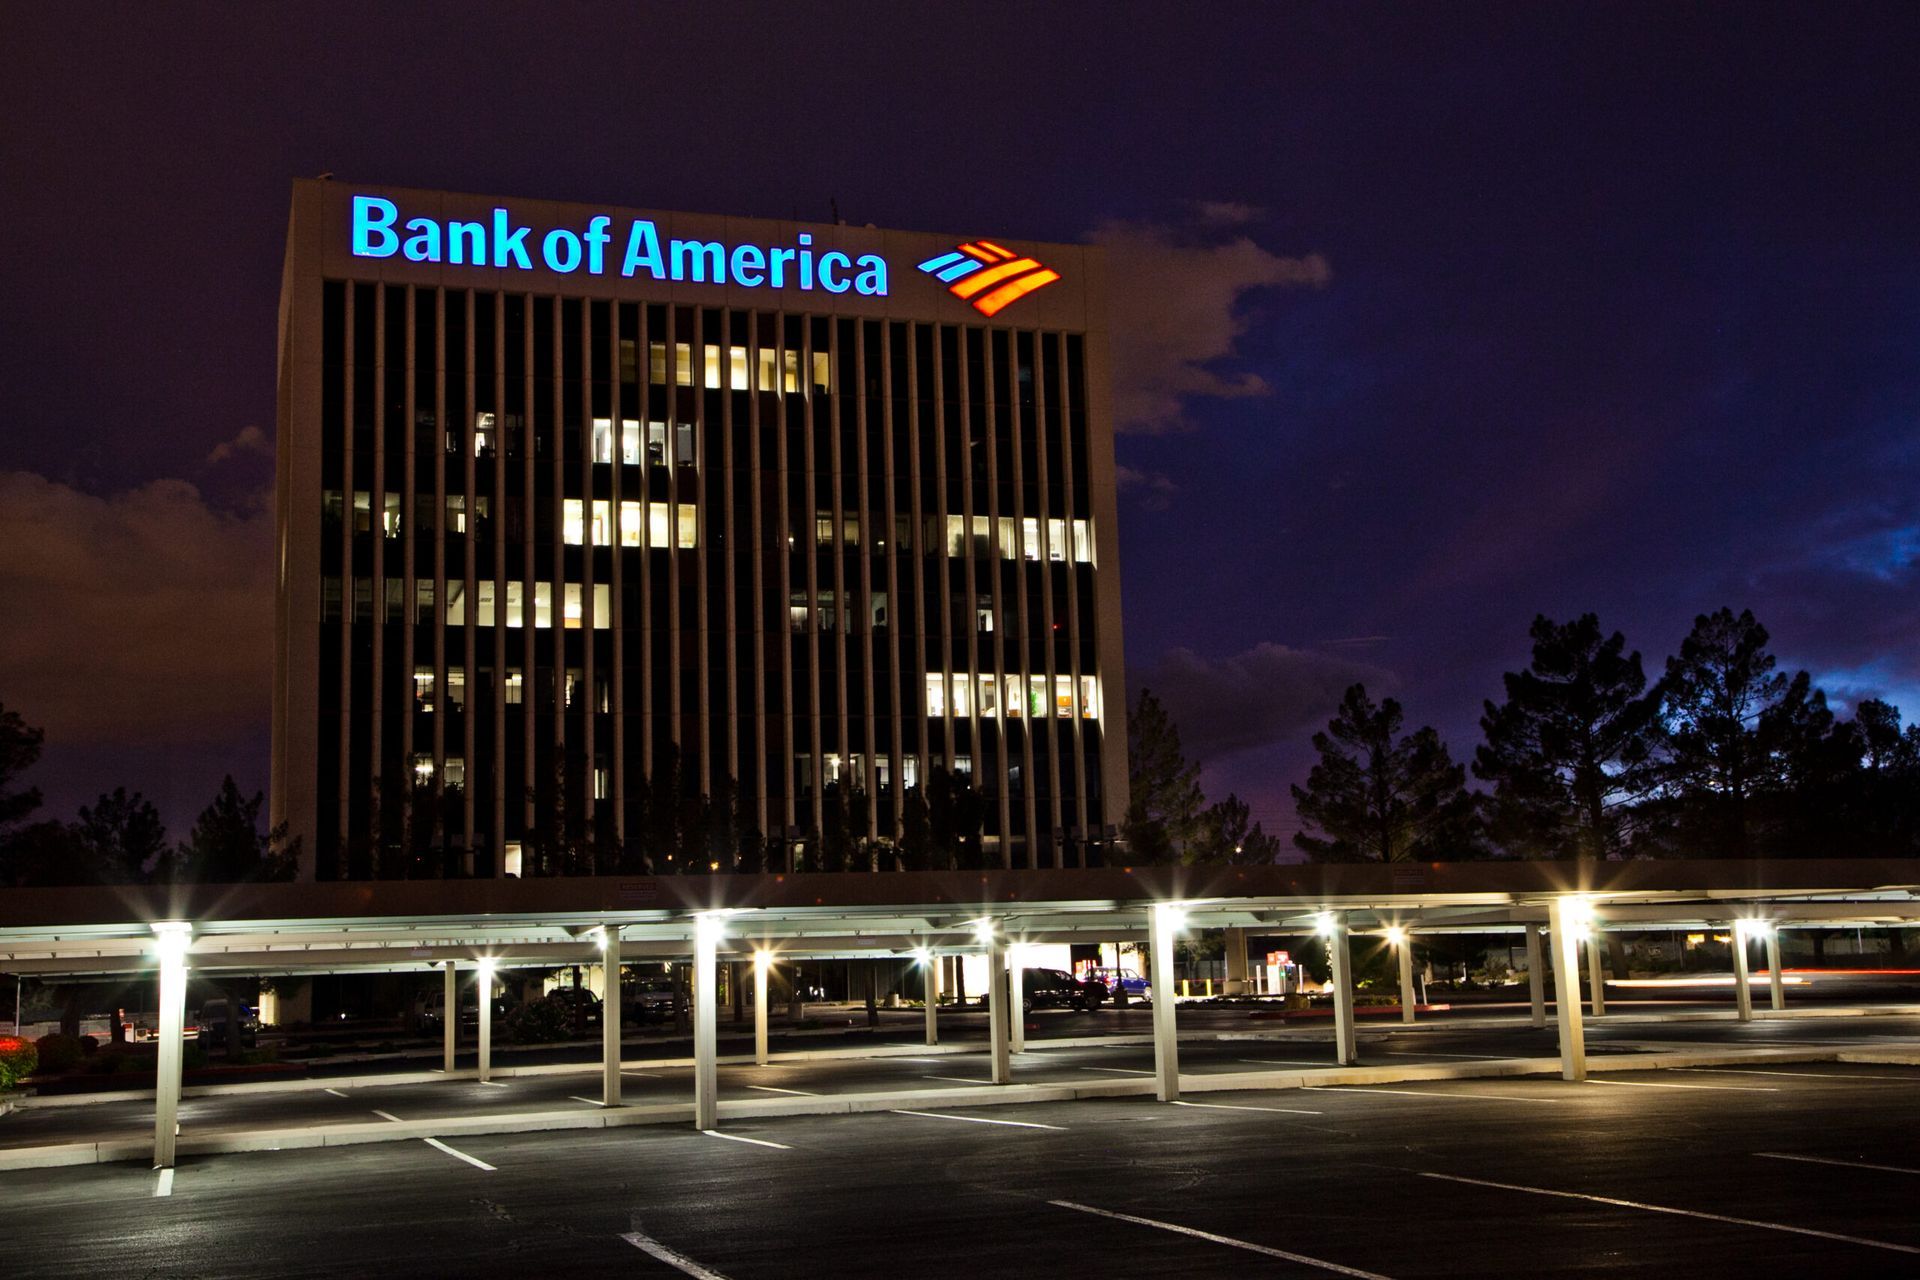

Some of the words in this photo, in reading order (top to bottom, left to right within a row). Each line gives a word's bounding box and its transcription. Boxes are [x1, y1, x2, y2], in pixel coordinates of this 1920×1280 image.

[351, 195, 533, 270] Bank
[542, 215, 613, 275] of
[621, 219, 889, 297] America
